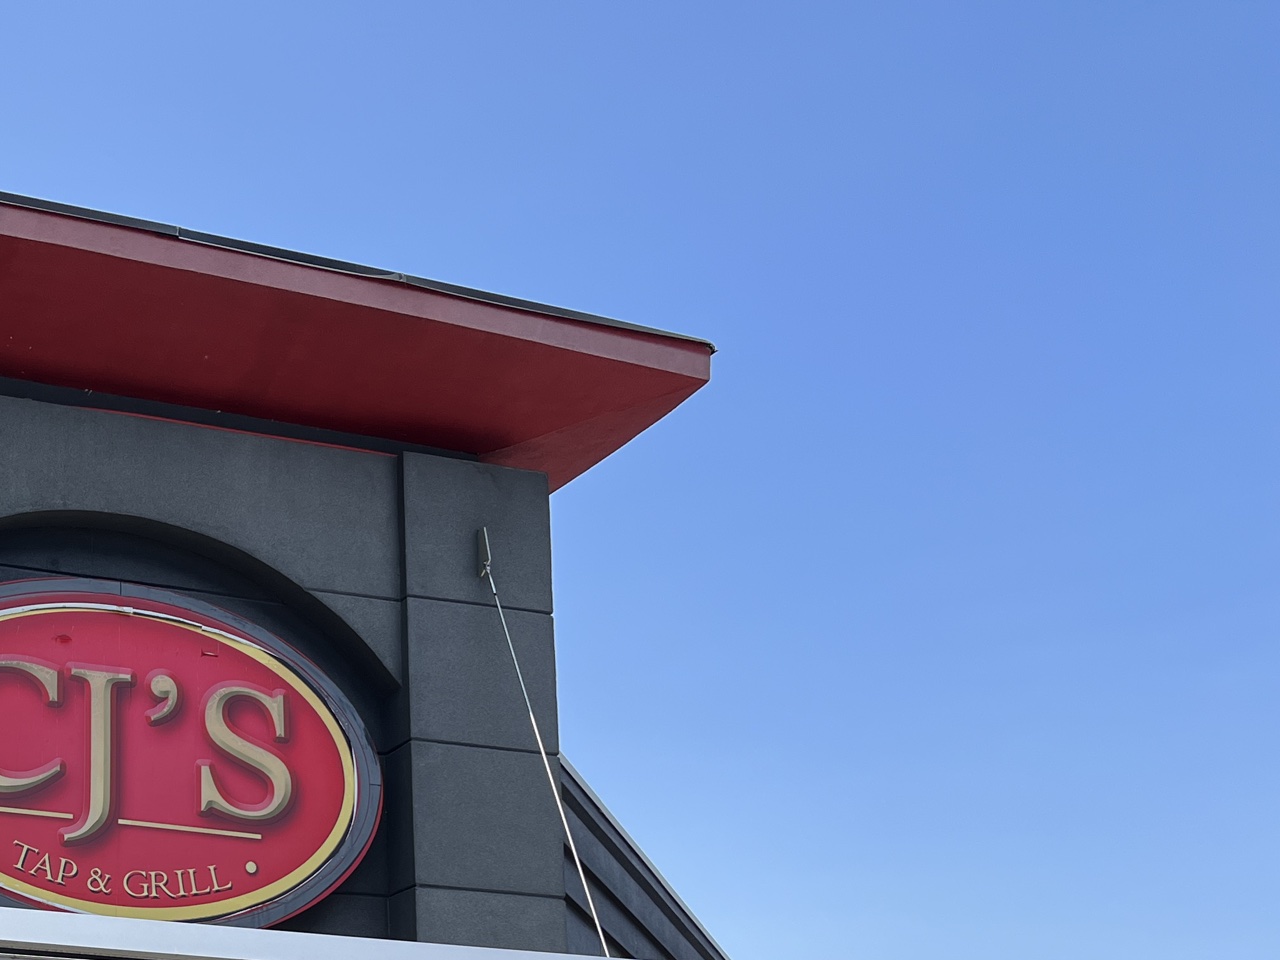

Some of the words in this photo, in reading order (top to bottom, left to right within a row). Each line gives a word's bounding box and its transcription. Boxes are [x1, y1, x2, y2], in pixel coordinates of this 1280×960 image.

[13, 839, 78, 885] TAP
[86, 867, 112, 894] &
[123, 864, 232, 899] GRILL
